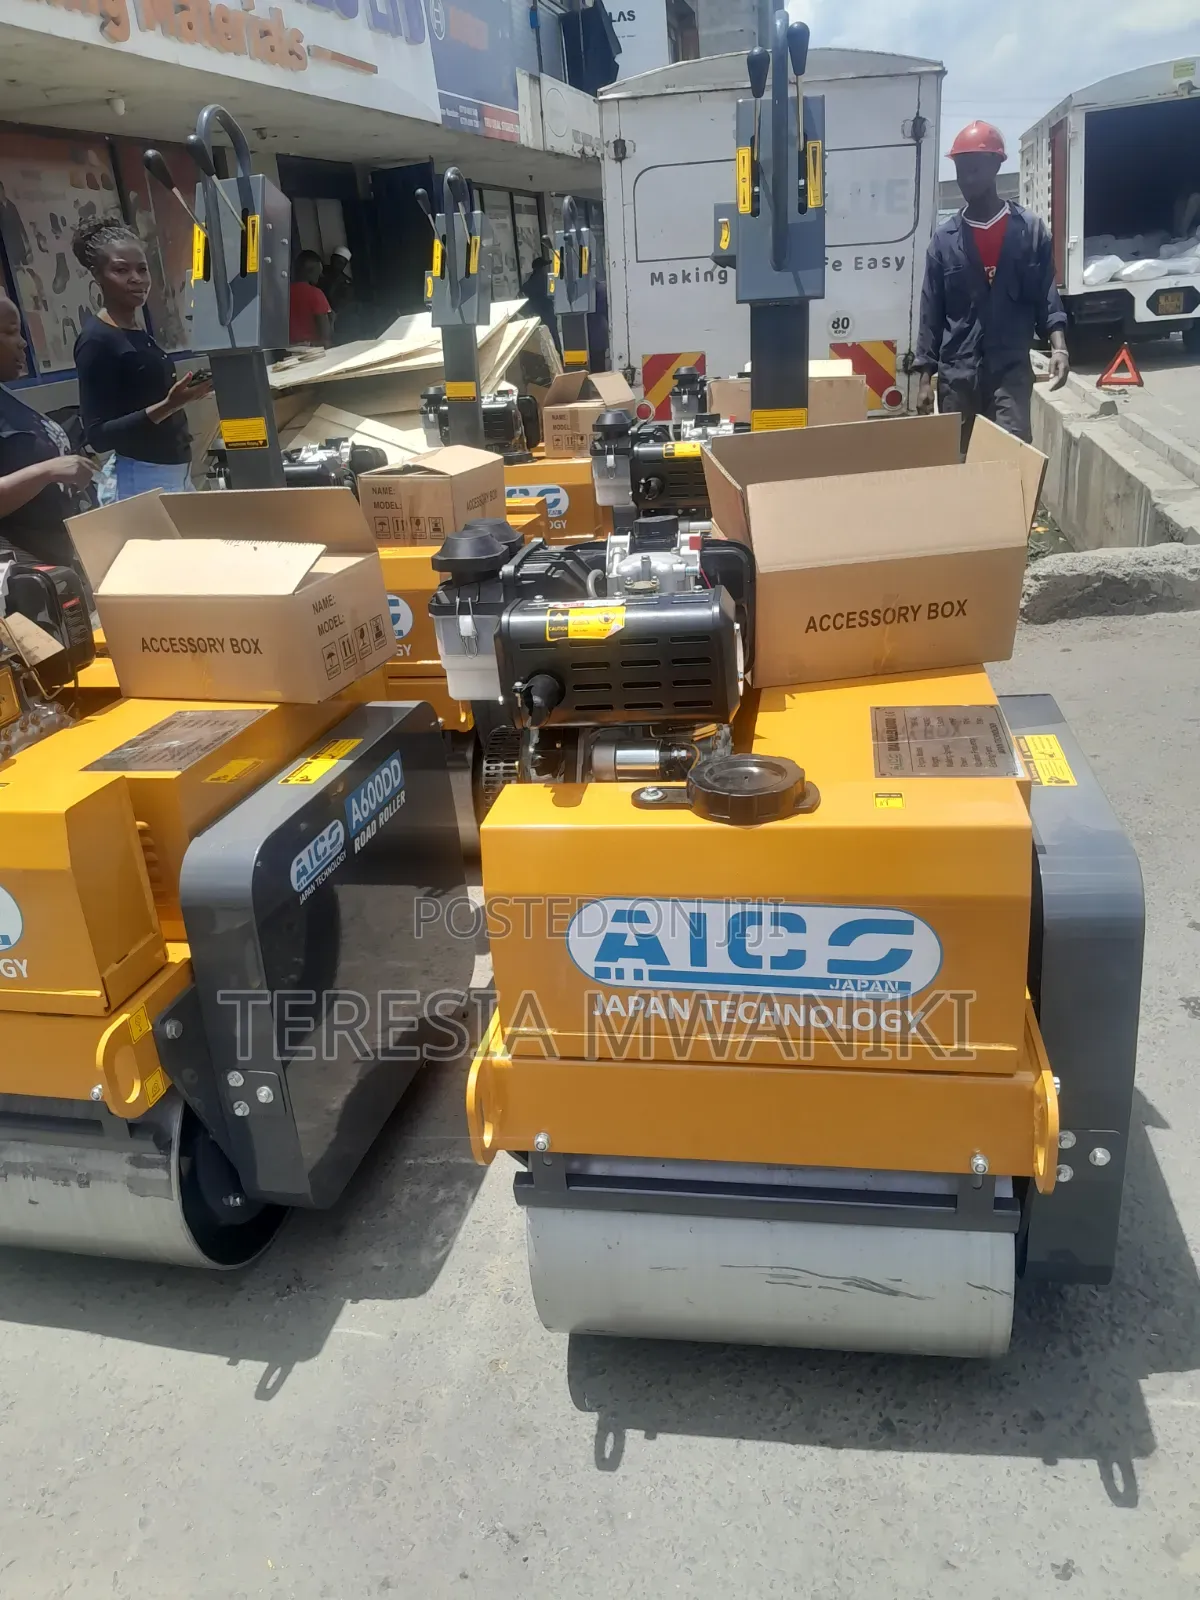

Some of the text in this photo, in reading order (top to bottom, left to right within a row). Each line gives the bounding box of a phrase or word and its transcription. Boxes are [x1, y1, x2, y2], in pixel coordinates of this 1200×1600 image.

[650, 267, 728, 286] Making
[854, 255, 905, 271] Easy
[831, 317, 850, 330] 80
[312, 594, 336, 615] NAME:
[805, 599, 968, 634] ACCESSORY BOX
[317, 614, 346, 636] MODEL:
[141, 637, 263, 655] ACCESSORY BOX
[351, 758, 401, 830] A600DD
[354, 790, 406, 854] ROAD ROLLER
[296, 820, 341, 885] AICS
[300, 884, 316, 906] JAPAN
[315, 851, 347, 886] TECHNOLOGY
[594, 908, 915, 979] AICS
[829, 979, 900, 993] JAPAN
[592, 994, 926, 1034] JAPAN TECHNOLOGY
